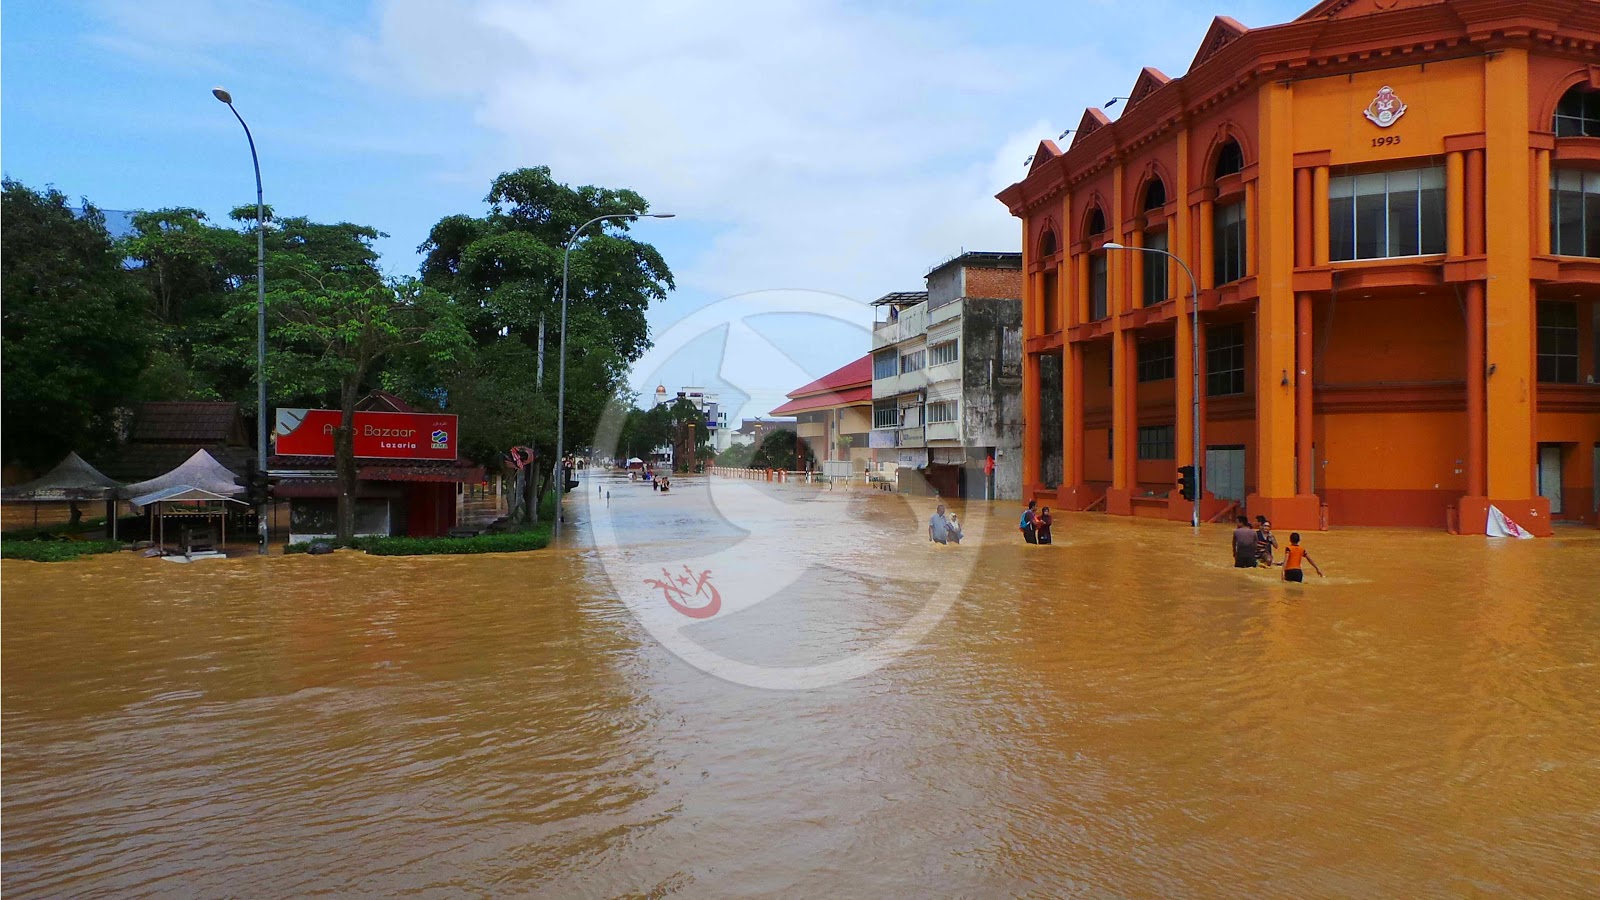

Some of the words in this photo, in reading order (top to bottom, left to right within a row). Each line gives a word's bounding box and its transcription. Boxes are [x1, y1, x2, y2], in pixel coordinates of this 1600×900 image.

[1371, 135, 1401, 148] 1993
[323, 423, 359, 436] Ao
[364, 424, 416, 437] Bazaar
[380, 441, 416, 449] Lazaria
